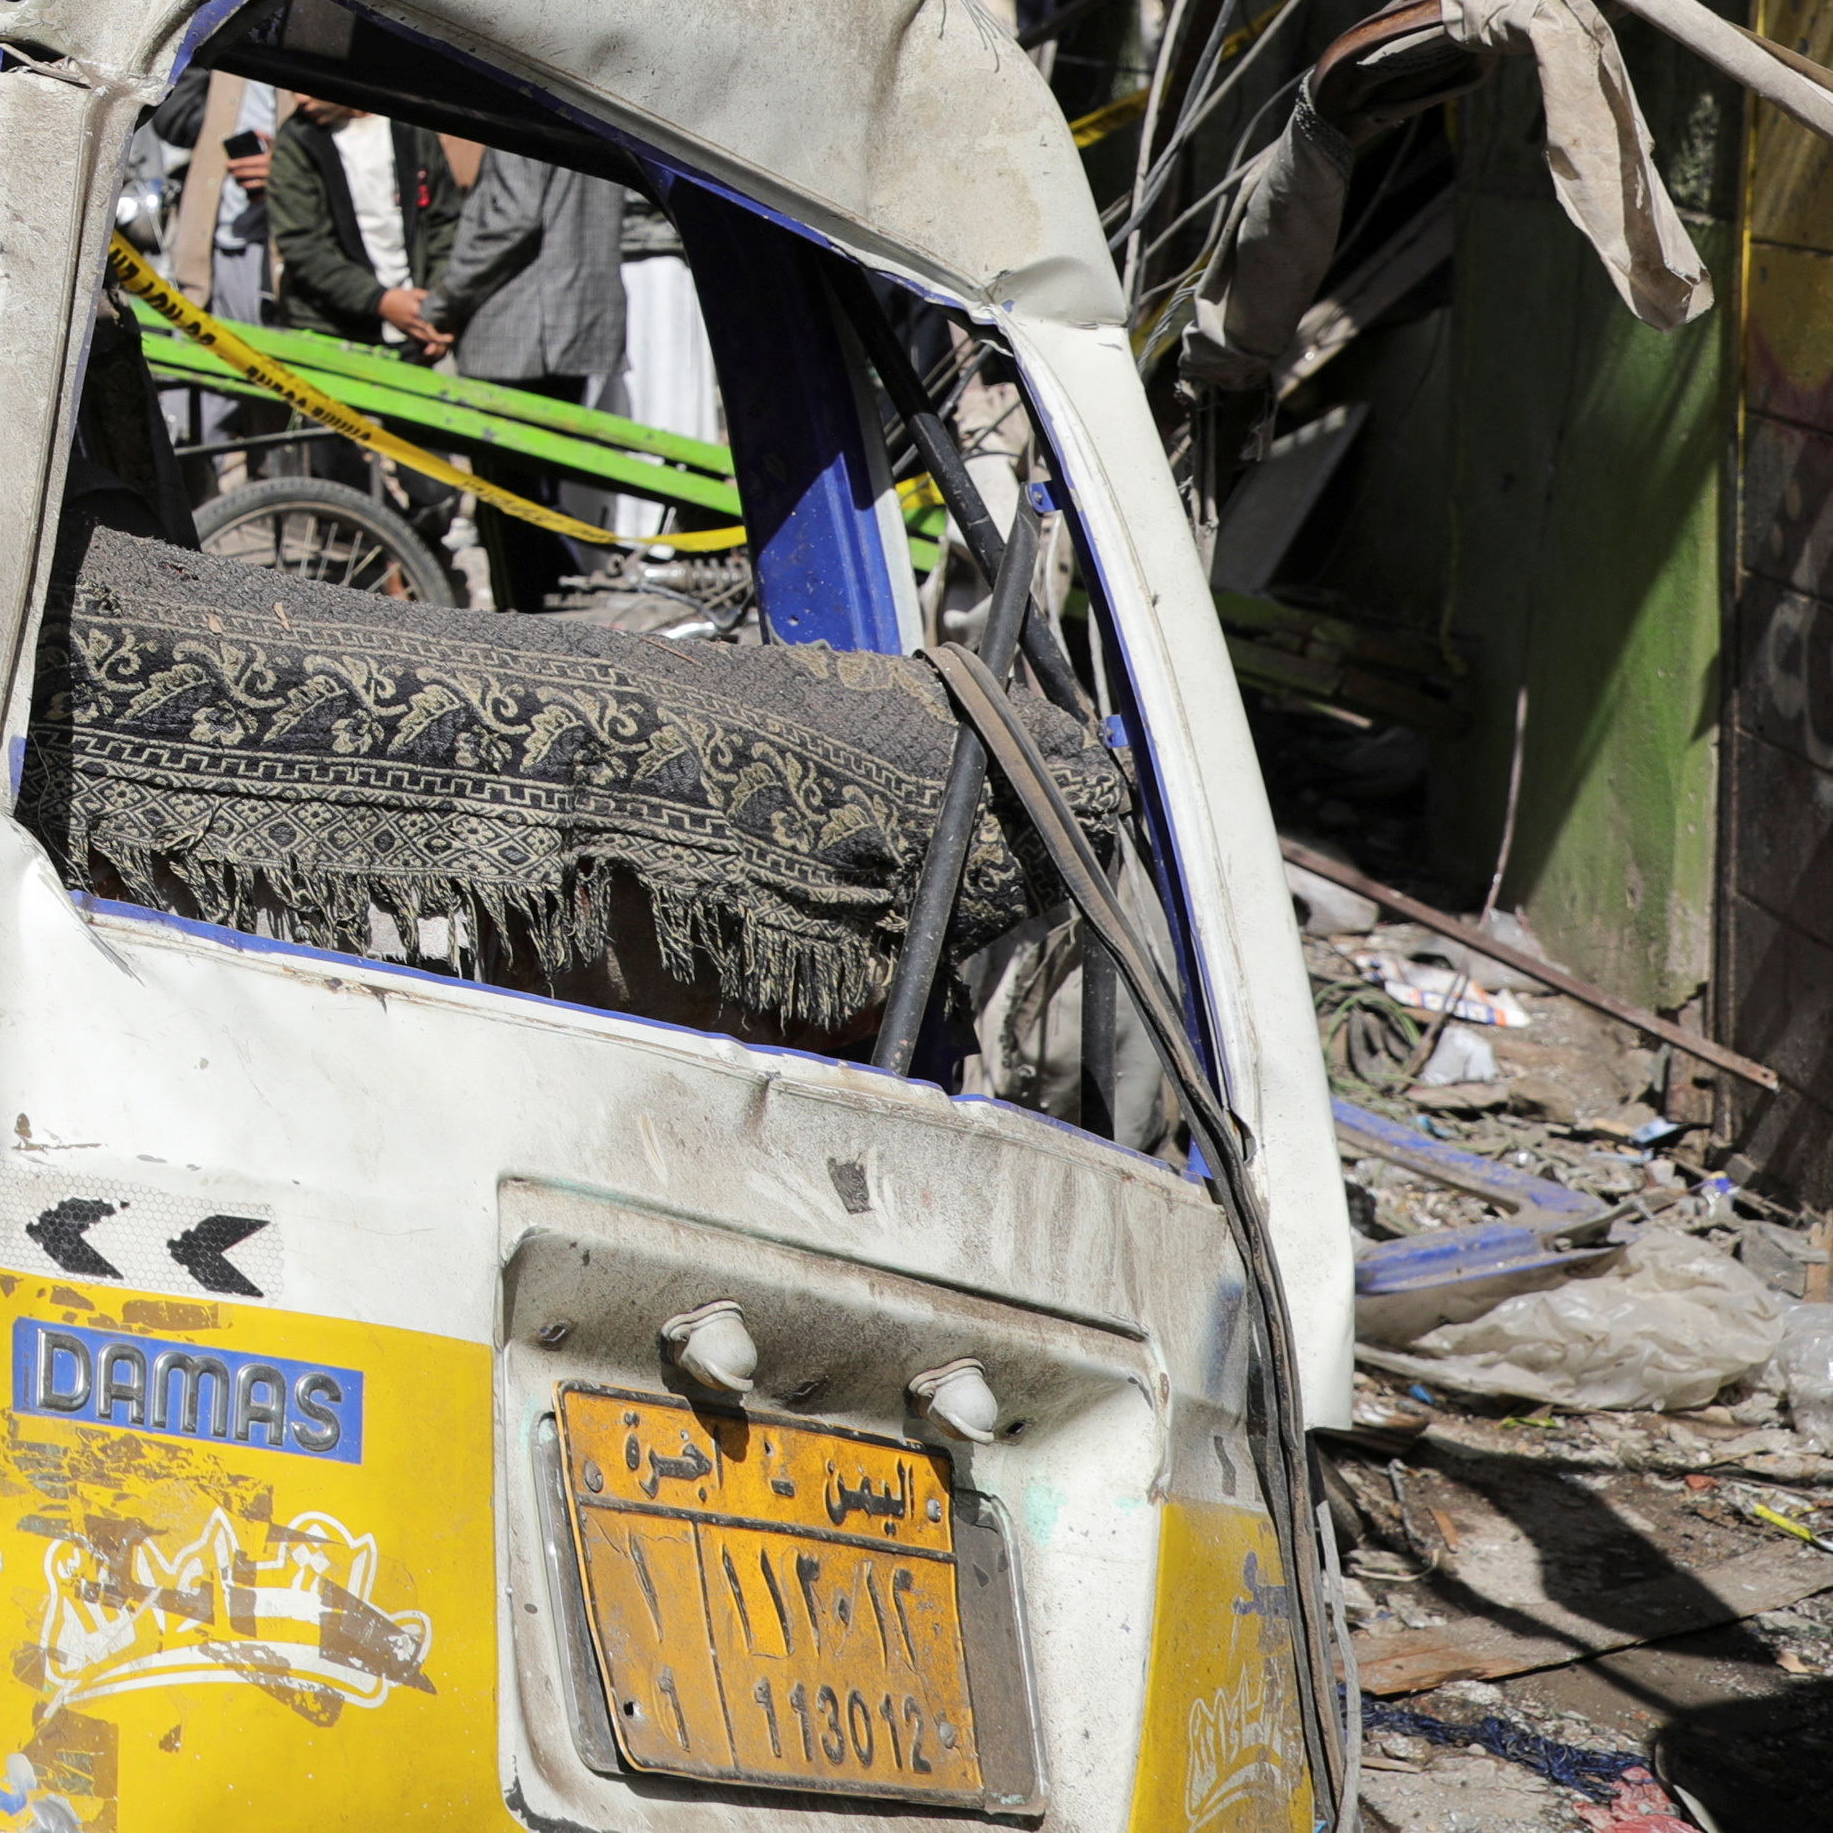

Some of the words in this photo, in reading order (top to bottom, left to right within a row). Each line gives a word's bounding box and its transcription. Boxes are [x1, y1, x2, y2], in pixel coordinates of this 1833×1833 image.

[36, 1328, 343, 1453] DAMAS
[823, 1455, 916, 1537] اليمن
[655, 1665, 691, 1753] 1
[753, 1675, 933, 1775] 113012
